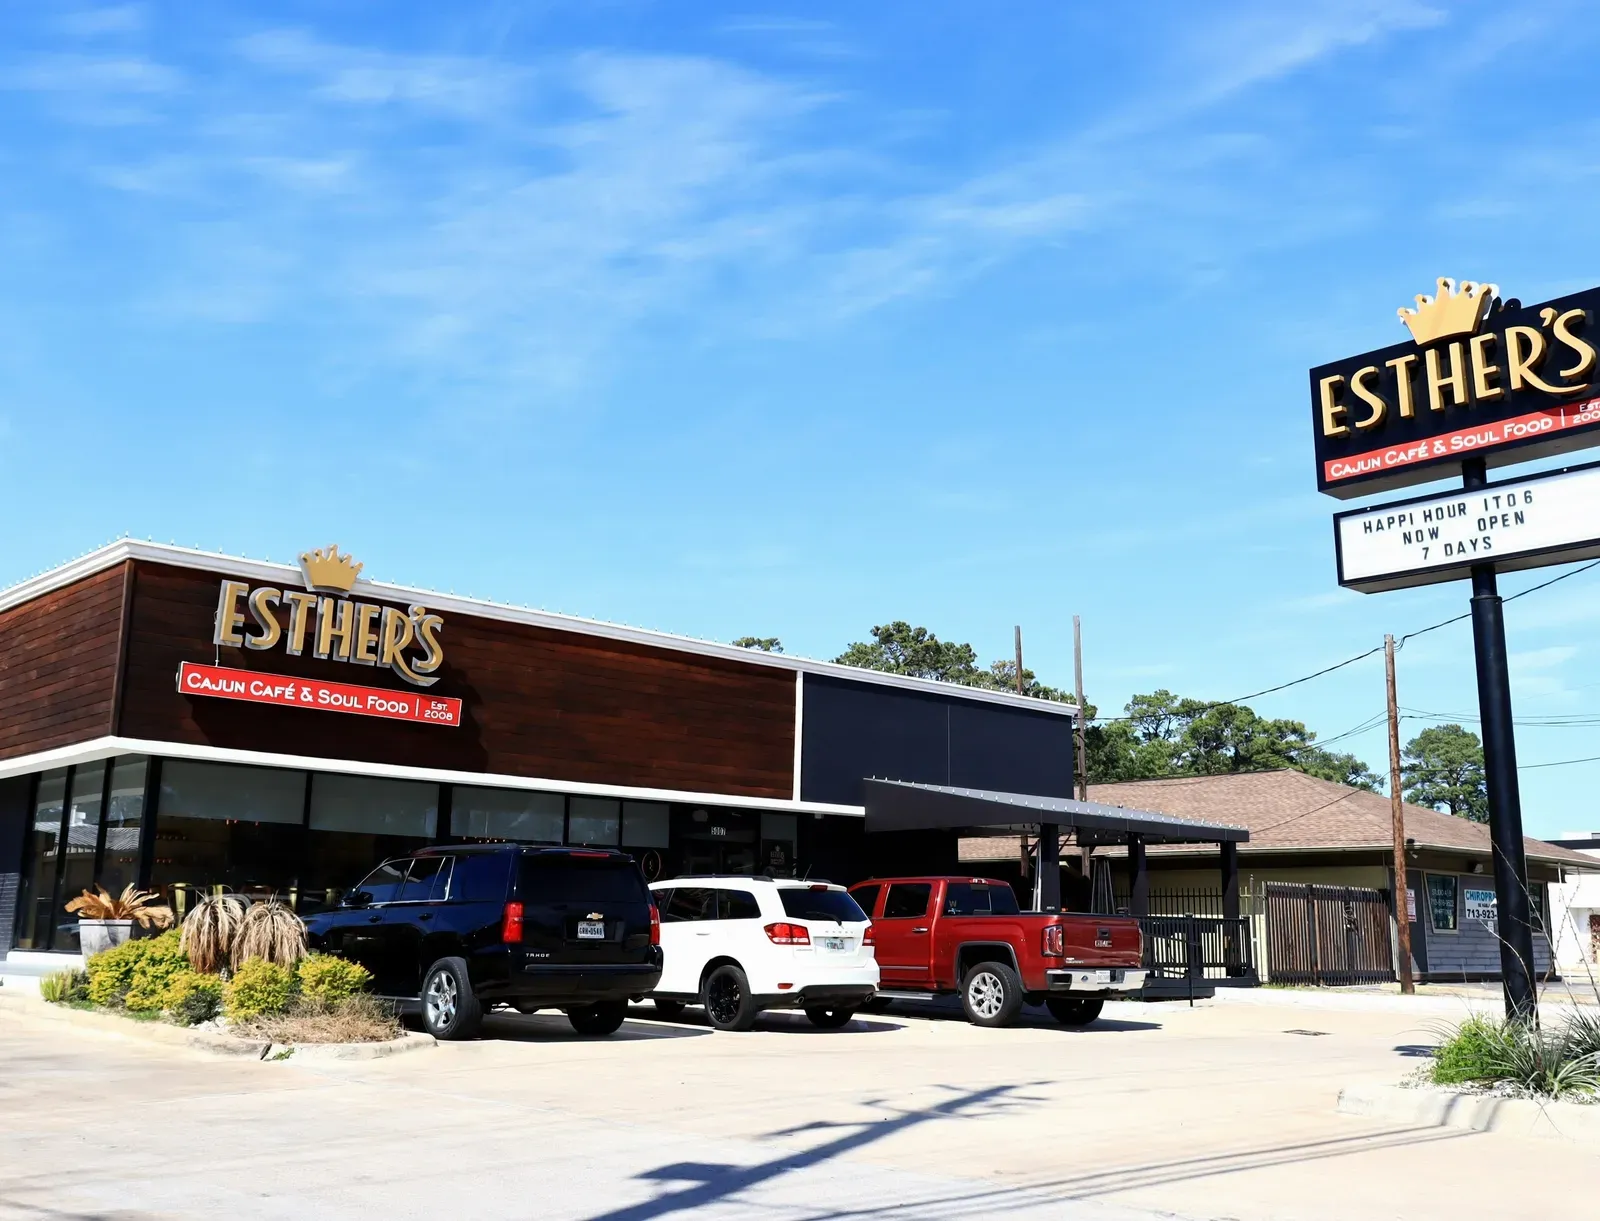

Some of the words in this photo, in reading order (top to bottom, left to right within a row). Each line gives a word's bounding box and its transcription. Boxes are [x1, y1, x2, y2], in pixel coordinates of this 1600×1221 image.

[1319, 307, 1597, 438] ESTHER'S
[1330, 455, 1382, 478] CAJUN
[1433, 440, 1447, 454] &
[1450, 431, 1500, 451] SOUL
[1503, 417, 1553, 439] FOOD
[1363, 512, 1414, 534] HAPPI
[1423, 502, 1467, 524] HOUR
[1403, 526, 1440, 546] NOW
[1477, 510, 1525, 532] OPEN
[1422, 547, 1430, 560] 7
[1444, 536, 1492, 557] DAYS
[215, 581, 445, 686] ESTHER'S
[186, 672, 246, 694] CAJUN
[300, 687, 314, 702] &
[317, 689, 363, 709] SOUL
[366, 696, 409, 714] FOOD
[424, 709, 453, 721] 2008
